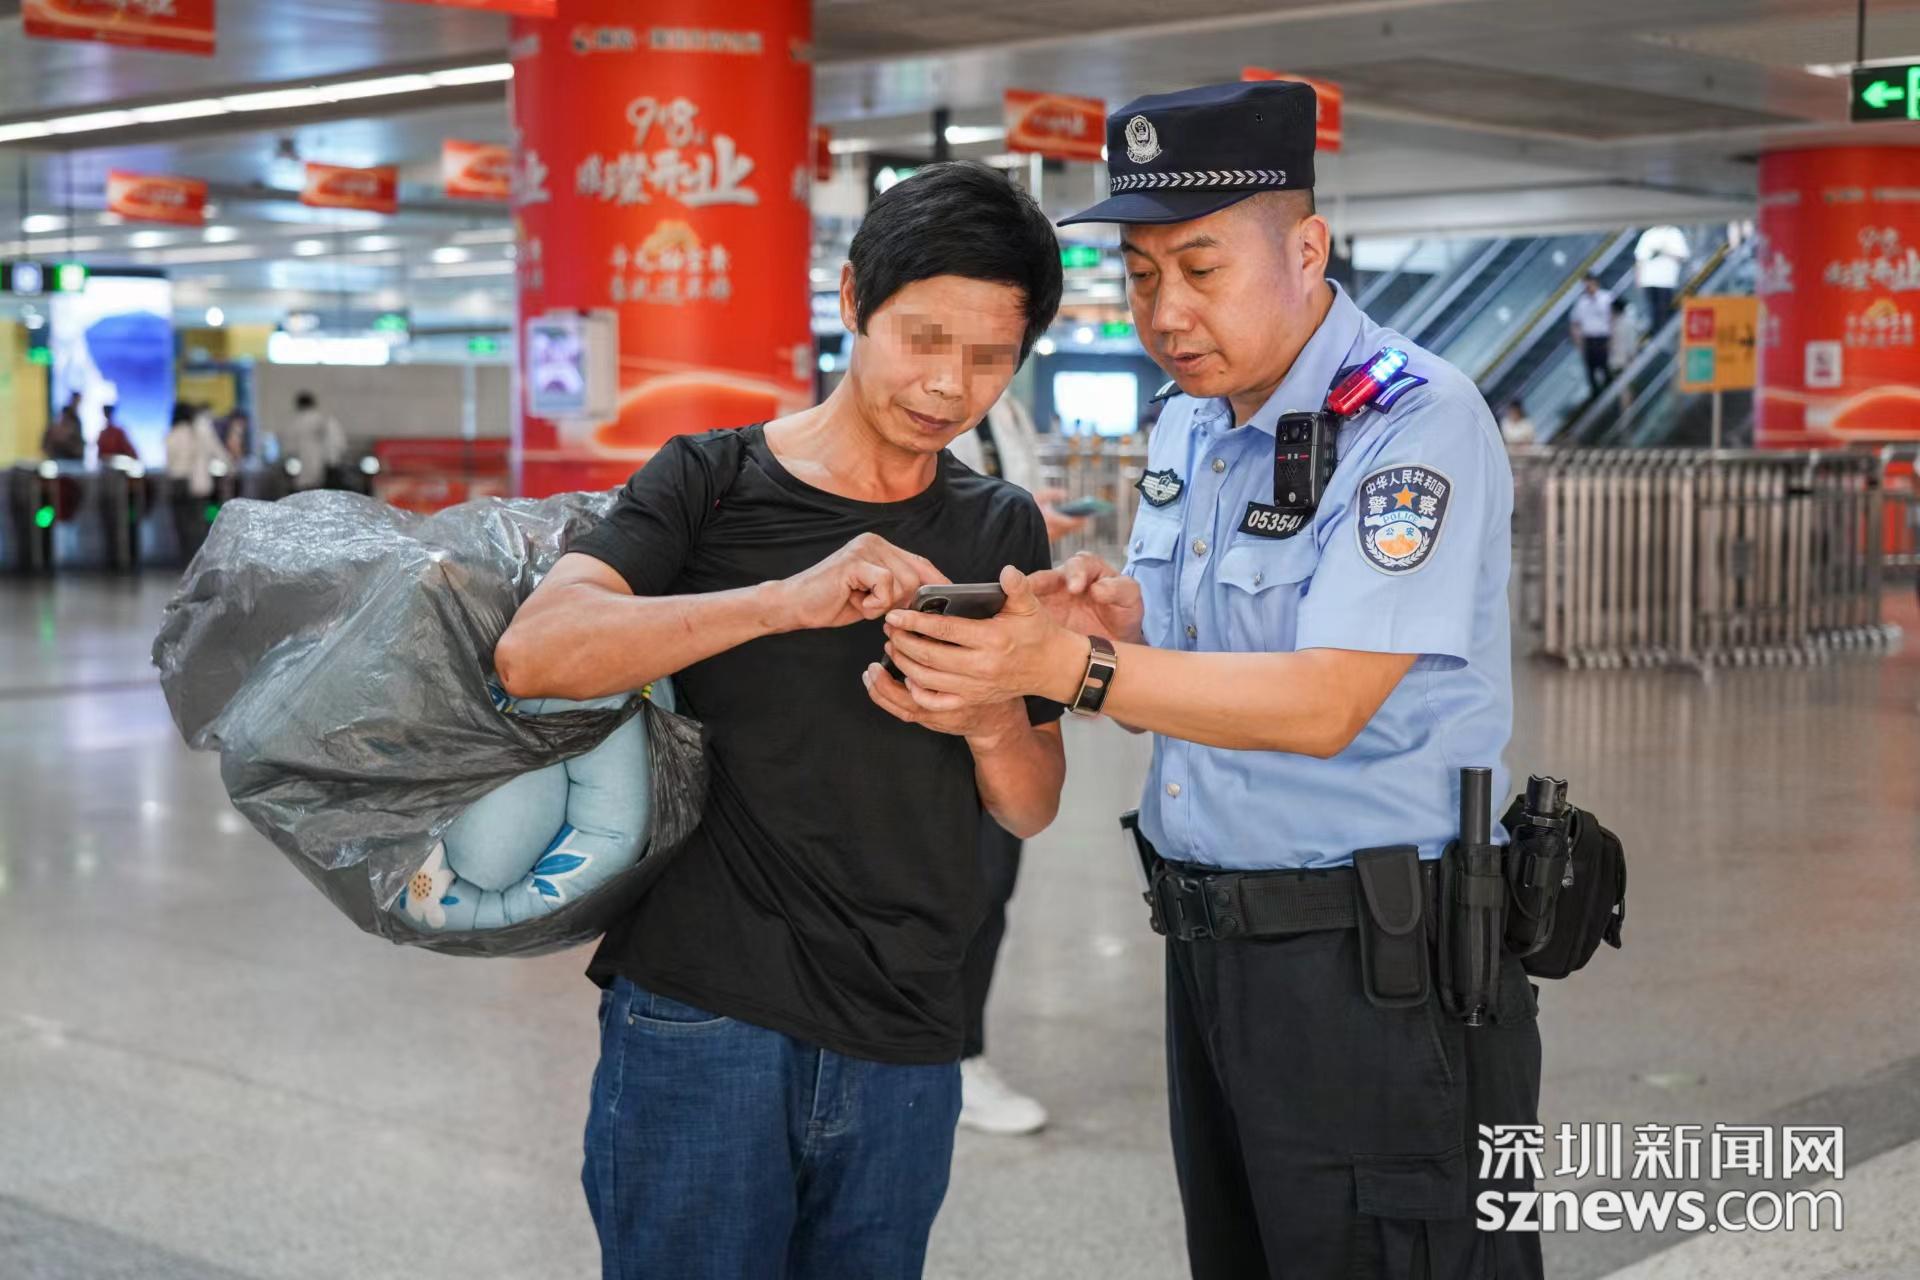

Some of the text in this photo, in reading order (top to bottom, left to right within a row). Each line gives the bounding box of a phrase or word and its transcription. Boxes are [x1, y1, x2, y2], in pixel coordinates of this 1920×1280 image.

[1365, 469, 1446, 497] 中华人民共和国
